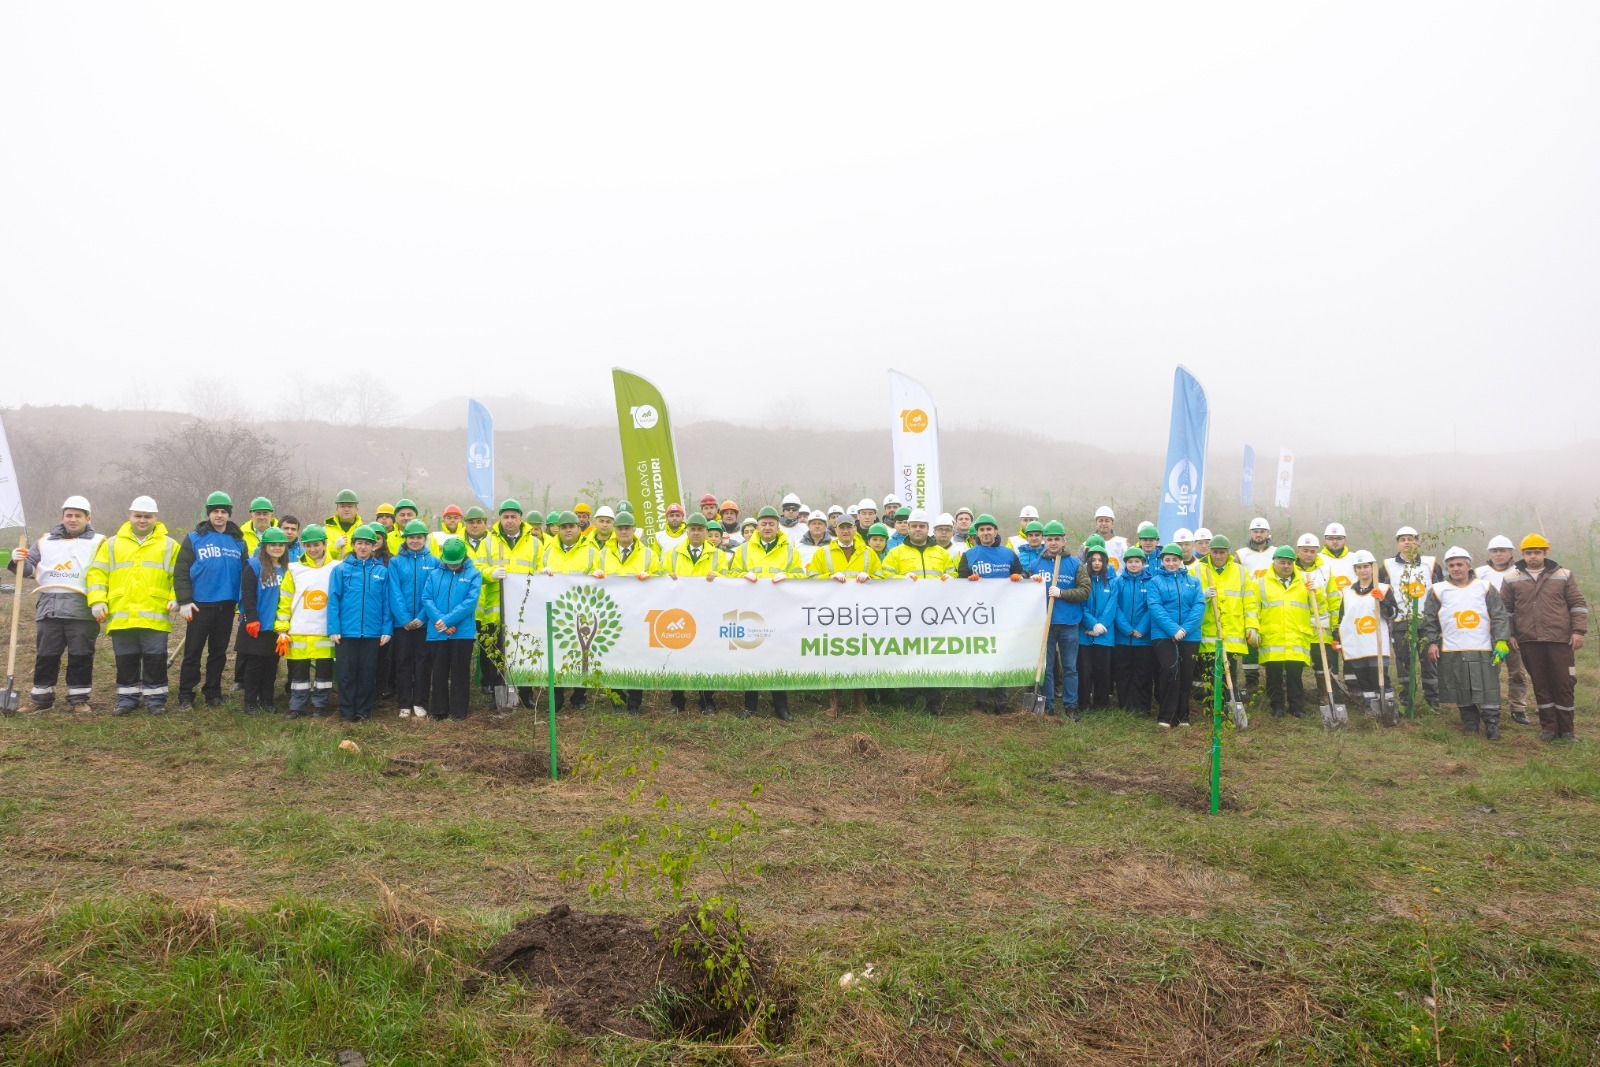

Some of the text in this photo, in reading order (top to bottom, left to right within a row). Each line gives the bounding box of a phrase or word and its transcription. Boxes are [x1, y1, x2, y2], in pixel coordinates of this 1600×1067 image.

[900, 408, 929, 434] 10
[637, 460, 651, 498] QAYĞI
[651, 457, 666, 530] SİYAMIZDIR!
[916, 463, 926, 509] MIZDIR!
[643, 608, 697, 650] 10
[801, 602, 996, 626] TƏBİƏTƏ QAYĞI
[800, 632, 997, 657] MİSSİYAMIZDIR!
